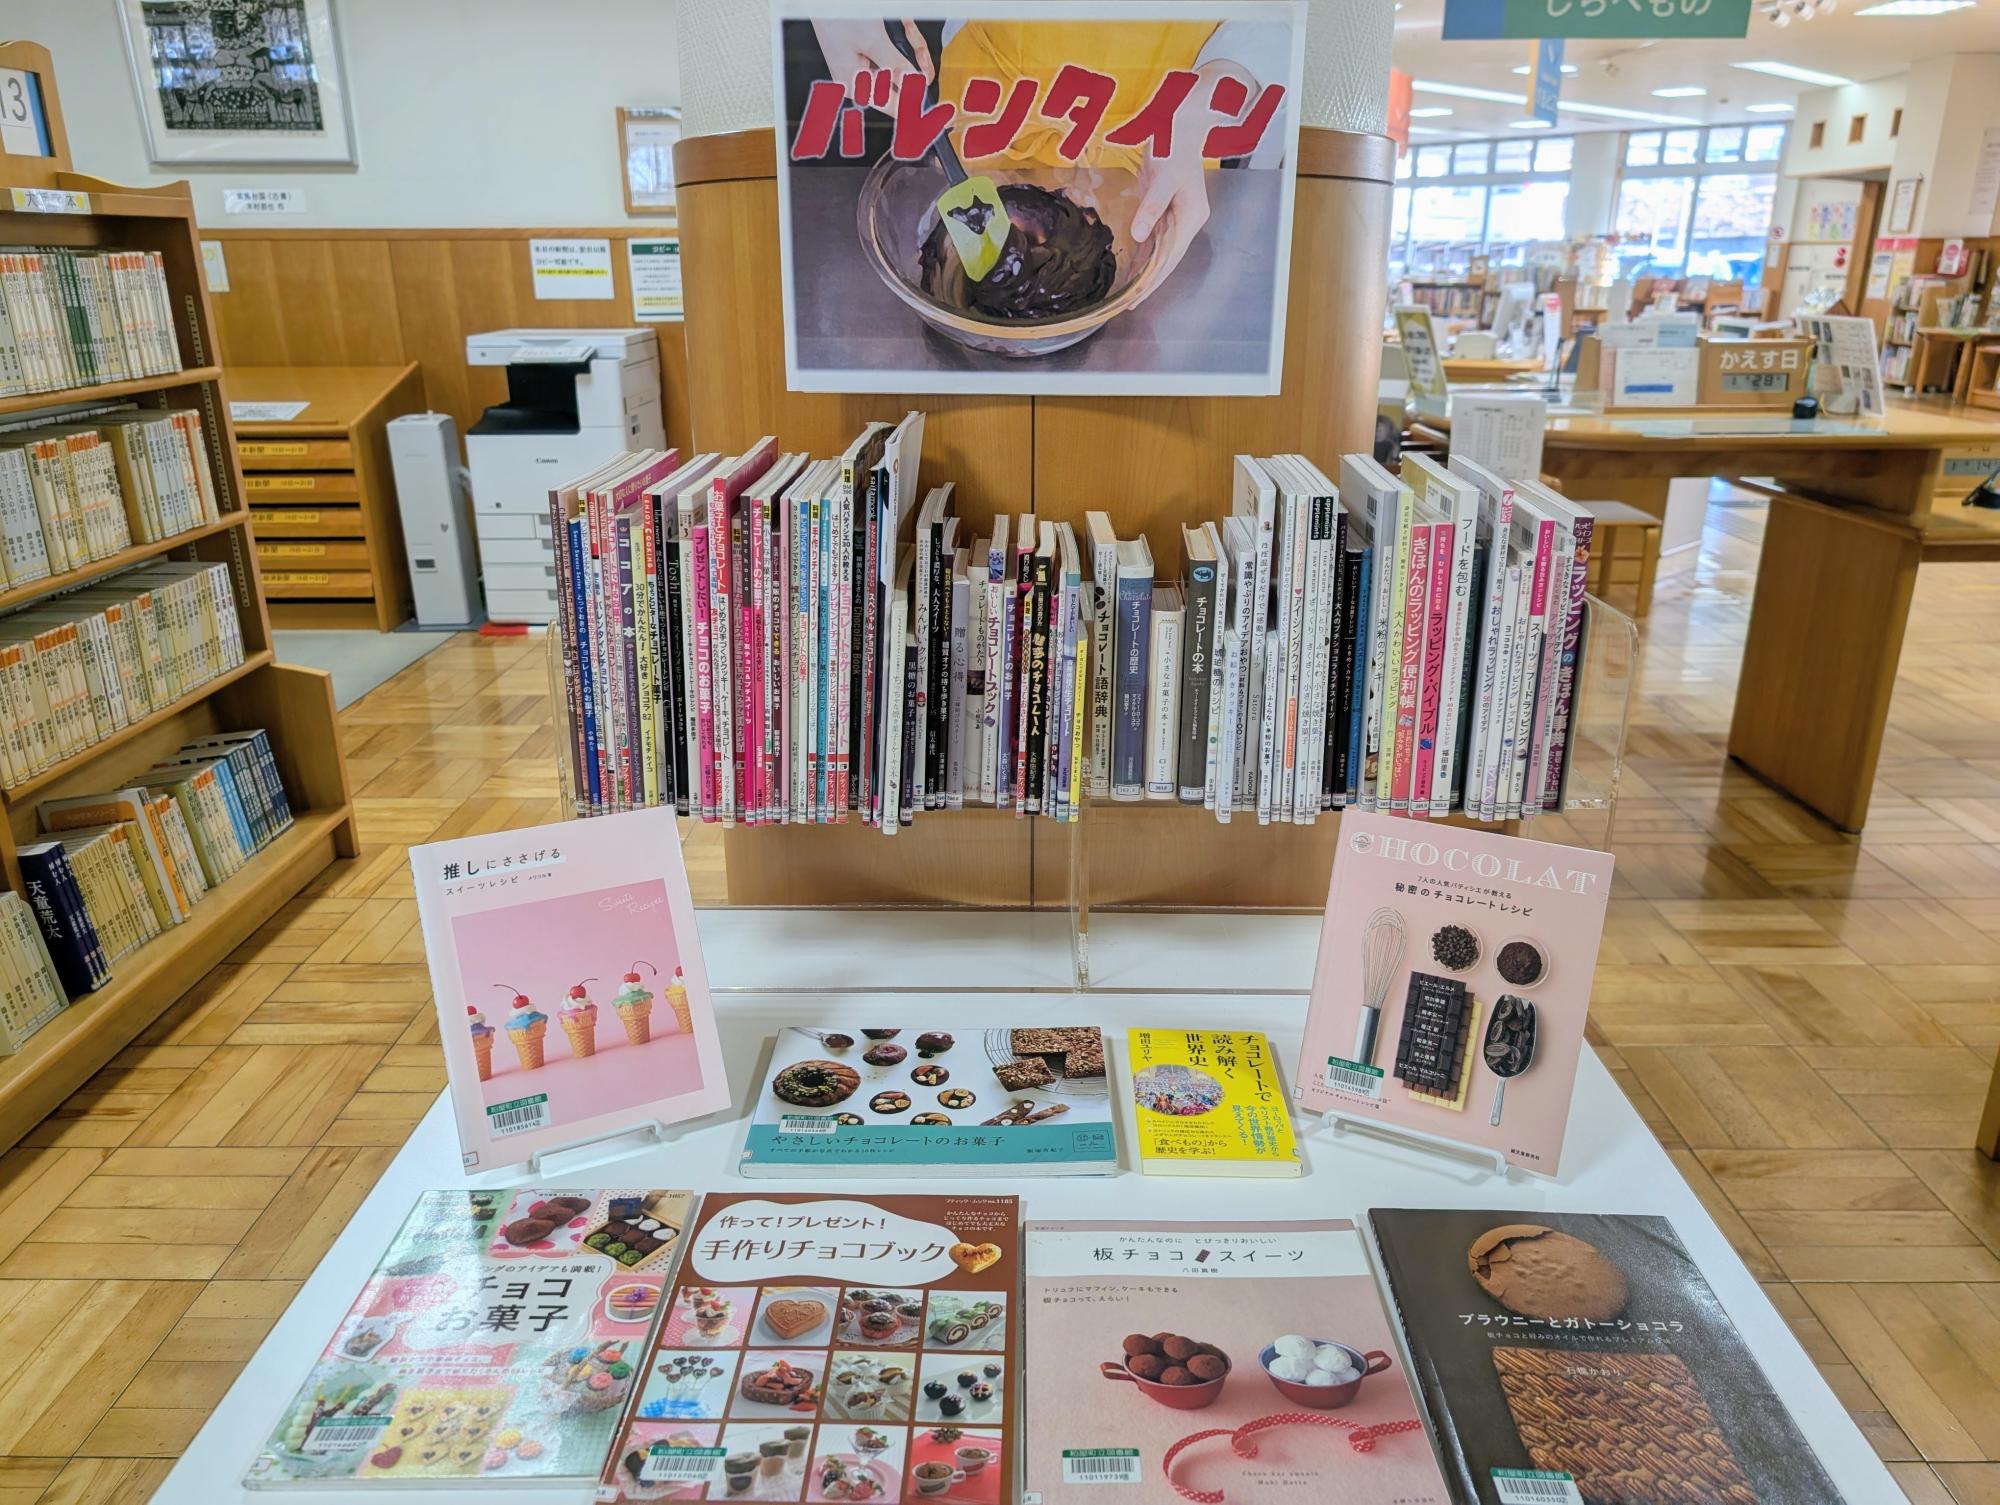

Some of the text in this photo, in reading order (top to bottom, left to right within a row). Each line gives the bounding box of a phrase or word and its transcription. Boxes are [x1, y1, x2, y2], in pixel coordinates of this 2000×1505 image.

[791, 64, 1286, 160] バレンタイン
[1720, 350, 1798, 369] かえす日
[843, 497, 851, 581] 人気パティシエ30人が教える
[1312, 498, 1320, 539] applemints
[645, 526, 654, 573] COOKING
[752, 505, 763, 609] チョコレートのお菓子
[810, 527, 819, 630] 手作りチョコスイーツ
[1455, 519, 1472, 597] フードを包む
[620, 537, 635, 638] ココアの本
[694, 535, 711, 714] プレゼントしたい! チョコのお菓子
[976, 581, 987, 666] チョコレートものがたり
[985, 586, 1001, 714] おいしいチョコレートブック
[1129, 601, 1141, 674] チョコレートの歴史
[1192, 596, 1208, 674] チョコレートの本
[1290, 597, 1302, 696] アイシングクッキー
[1399, 537, 1426, 708] きほんのラッピング便利帳
[1483, 606, 1501, 692] おしゃれラッピング
[580, 641, 593, 717] チョコレートのお菓子
[639, 656, 648, 679] 大好き
[1004, 604, 1016, 701] チョコレートのお菓子
[1094, 611, 1110, 717] チョコレート語辞典
[1373, 619, 1388, 692] 米粉のクッキー
[1388, 611, 1404, 708] 大人かわいいラッピング
[1420, 613, 1445, 734] ラッピング・バイブル
[1510, 617, 1527, 700] おしゃれなラッピング
[641, 682, 649, 712] ショコラ
[907, 661, 916, 717] 黒糖のお菓子
[1161, 656, 1171, 720] 小さなお菓子の本
[443, 848, 560, 880] 推しにささげる
[446, 875, 519, 896] スイーツレシピ
[1350, 831, 1597, 895] CHOCOLAT
[1418, 875, 1512, 899] 7人の人気パティシエが教える
[25, 880, 63, 939] 天童荒太
[1394, 881, 1533, 917] 秘密のチョコレートレシピ
[1139, 1032, 1153, 1062] 増田ユリヤ
[1185, 1033, 1209, 1067] 世界史
[1212, 1034, 1237, 1079] 読み解く
[1239, 1035, 1272, 1102] チョコレートで
[771, 1136, 1006, 1146] やさしいチョコレートのお菓子
[1154, 1138, 1227, 1147] 「食べもの」から
[1156, 1147, 1216, 1156] 歴史を学ぶ!
[700, 1239, 946, 1263] 手作りチョコブック
[719, 1215, 886, 1229] 作って!プレゼント!
[1119, 1236, 1183, 1244] かんたんなのに
[1093, 1247, 1304, 1262] 板チョコ スイーツ
[480, 1276, 573, 1301] チョコ
[1044, 1285, 1179, 1293] トリュフにマフィン、ケーキもできる
[435, 1304, 570, 1333] お菓子
[1458, 1314, 1684, 1332] ブラウニーとガトーショコラ
